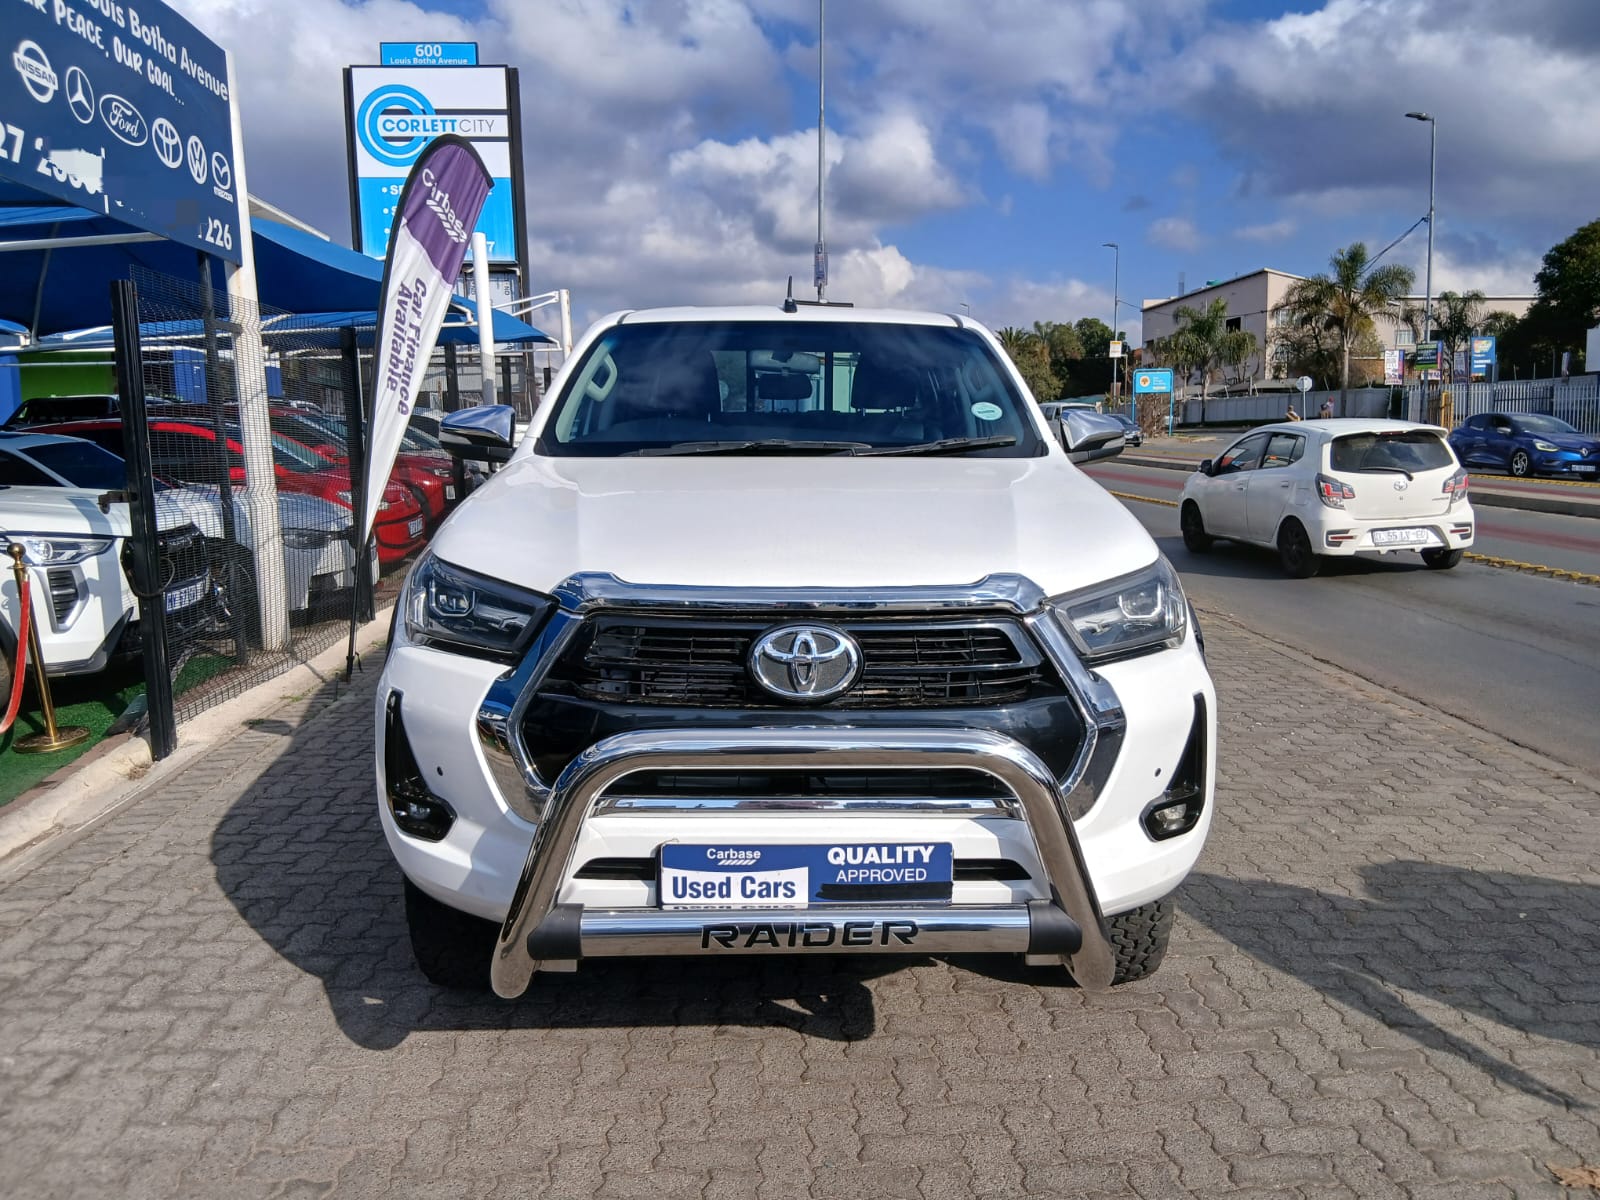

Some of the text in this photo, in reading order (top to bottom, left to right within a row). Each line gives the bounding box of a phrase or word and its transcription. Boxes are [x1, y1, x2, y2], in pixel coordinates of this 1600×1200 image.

[85, 0, 229, 101] ouis Botha Avenue
[113, 36, 143, 75] OUR
[390, 57, 468, 65] Louis Botha Avenue
[415, 44, 442, 57] 600
[17, 57, 56, 84] NISSAN
[109, 101, 139, 138] Ford
[382, 119, 495, 133] CORLETT CITY
[386, 281, 413, 393] Available
[397, 277, 427, 416] Car Finance
[706, 848, 761, 860] Carbase
[827, 846, 935, 866] QUALITY
[672, 876, 796, 899] Used Cars
[836, 868, 927, 883] APPROVED
[701, 920, 920, 950] RAIDER
